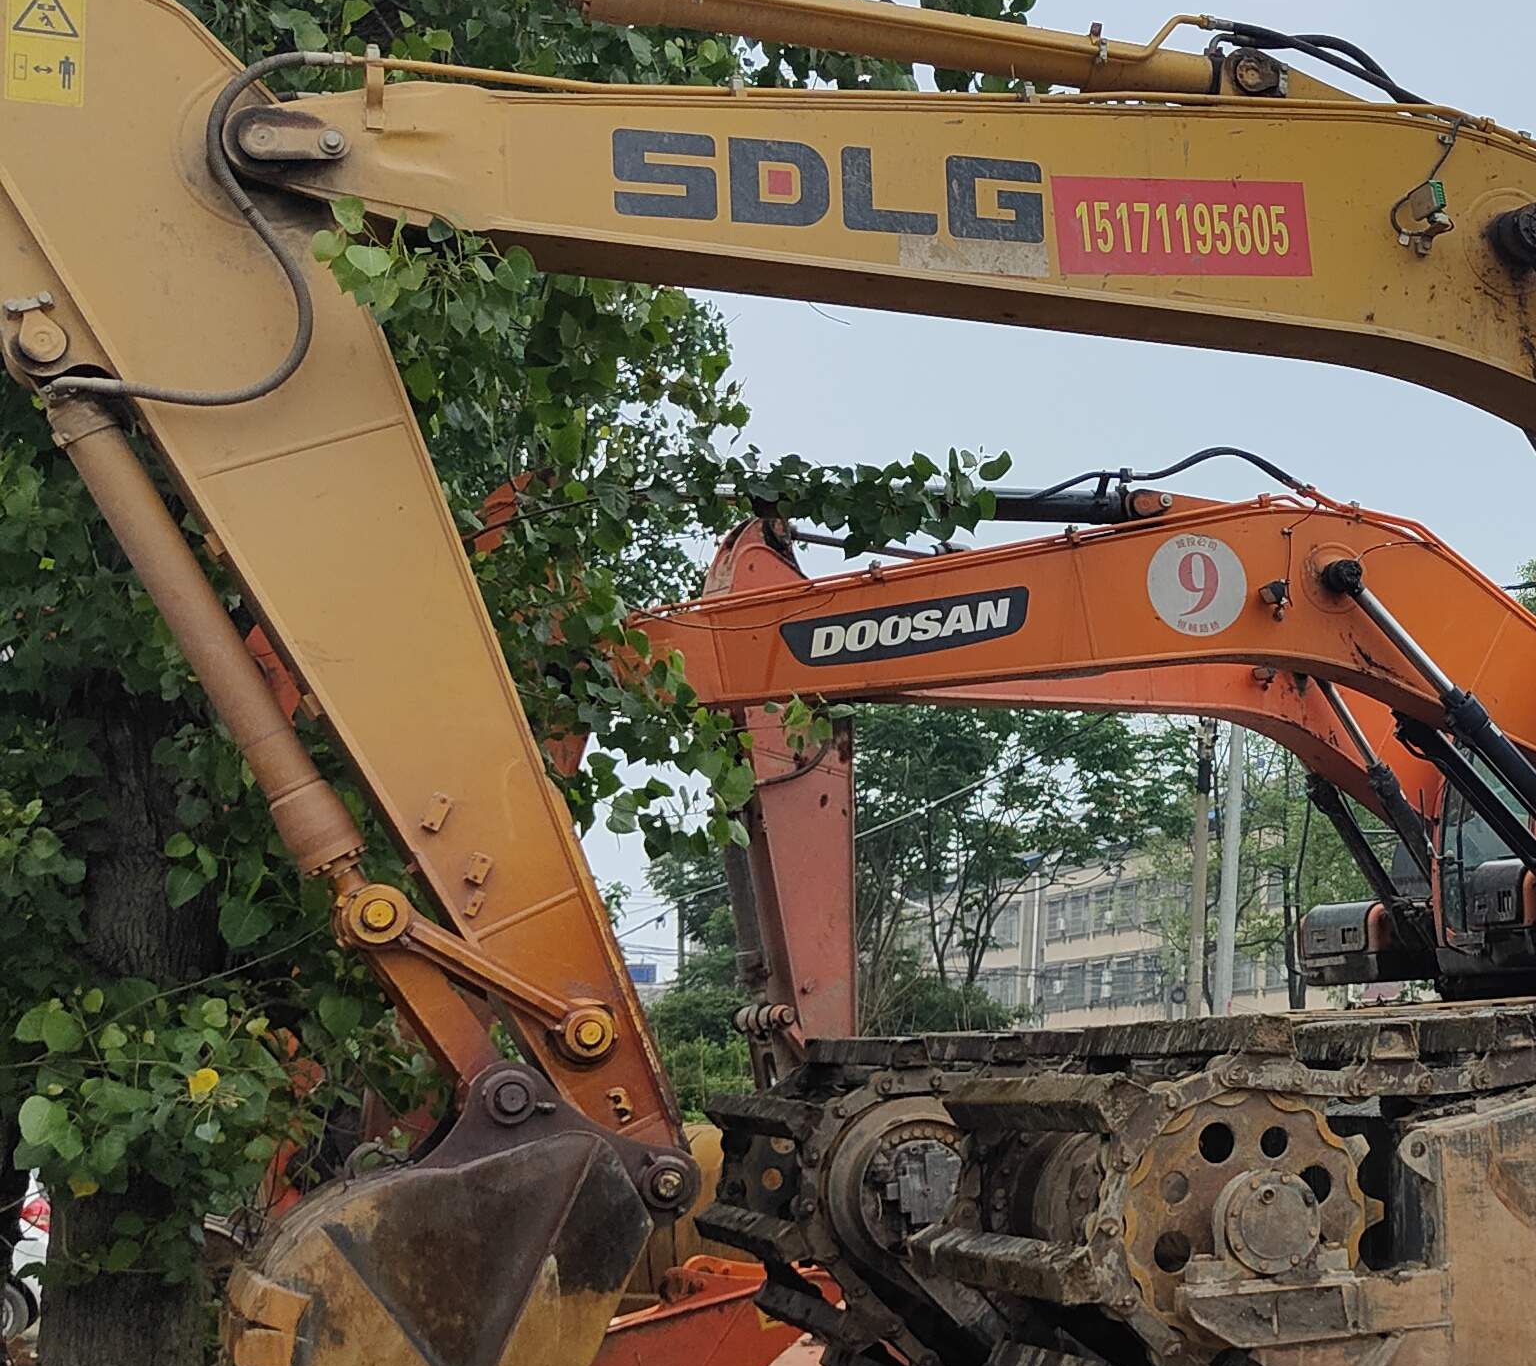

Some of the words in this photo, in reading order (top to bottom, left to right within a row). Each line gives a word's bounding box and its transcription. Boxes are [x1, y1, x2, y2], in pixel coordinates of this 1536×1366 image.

[612, 128, 1044, 243] SDLG
[1075, 201, 1290, 256] 15171195605
[1178, 551, 1219, 617] 9
[810, 597, 1011, 659] DOOSAN
